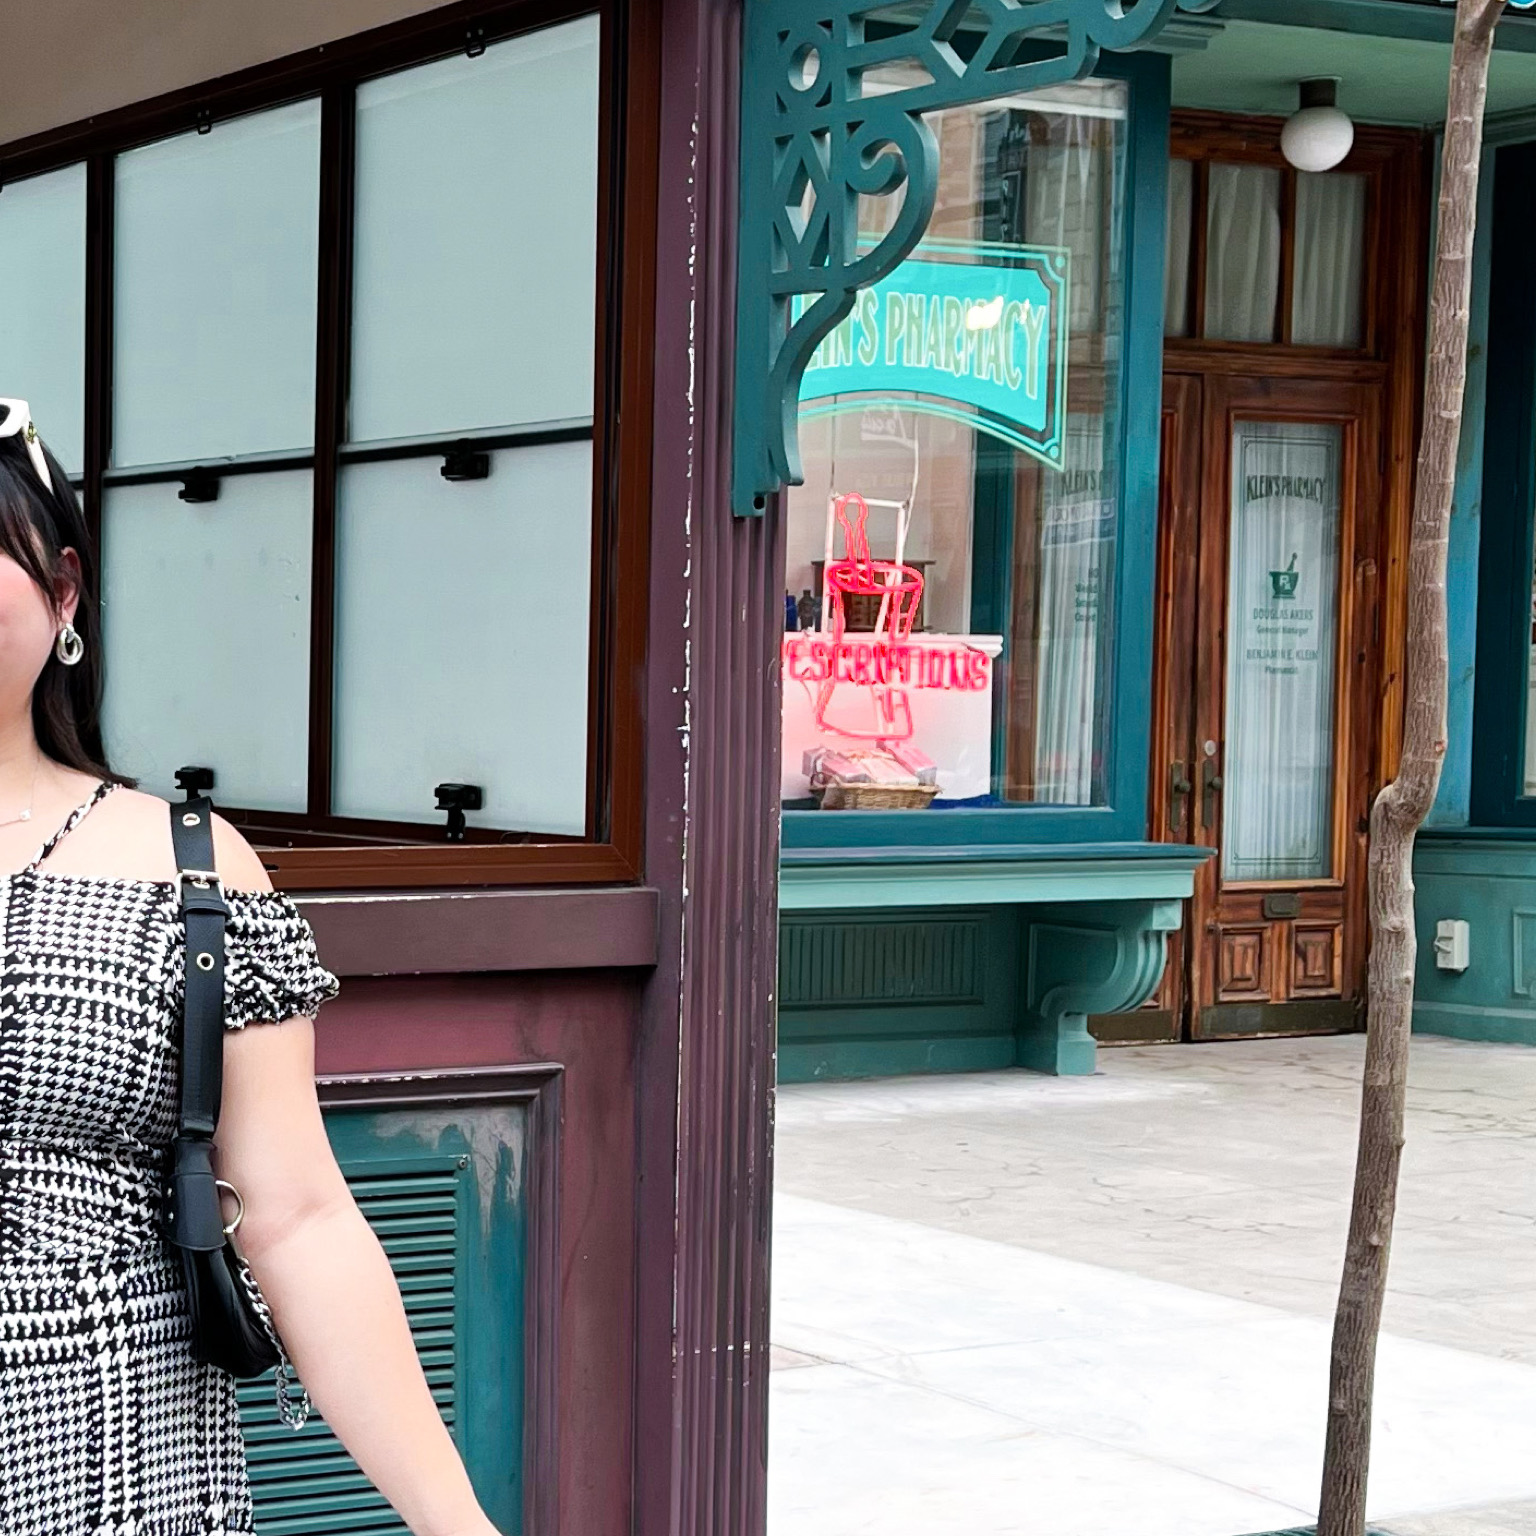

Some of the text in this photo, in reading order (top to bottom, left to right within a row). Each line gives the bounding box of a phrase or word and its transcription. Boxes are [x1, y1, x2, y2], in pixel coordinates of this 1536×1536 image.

[885, 291, 1047, 400] PHARMACY
[1246, 474, 1325, 504] KLEIN'S PHARMACY
[1253, 607, 1289, 620] DOUGLAS
